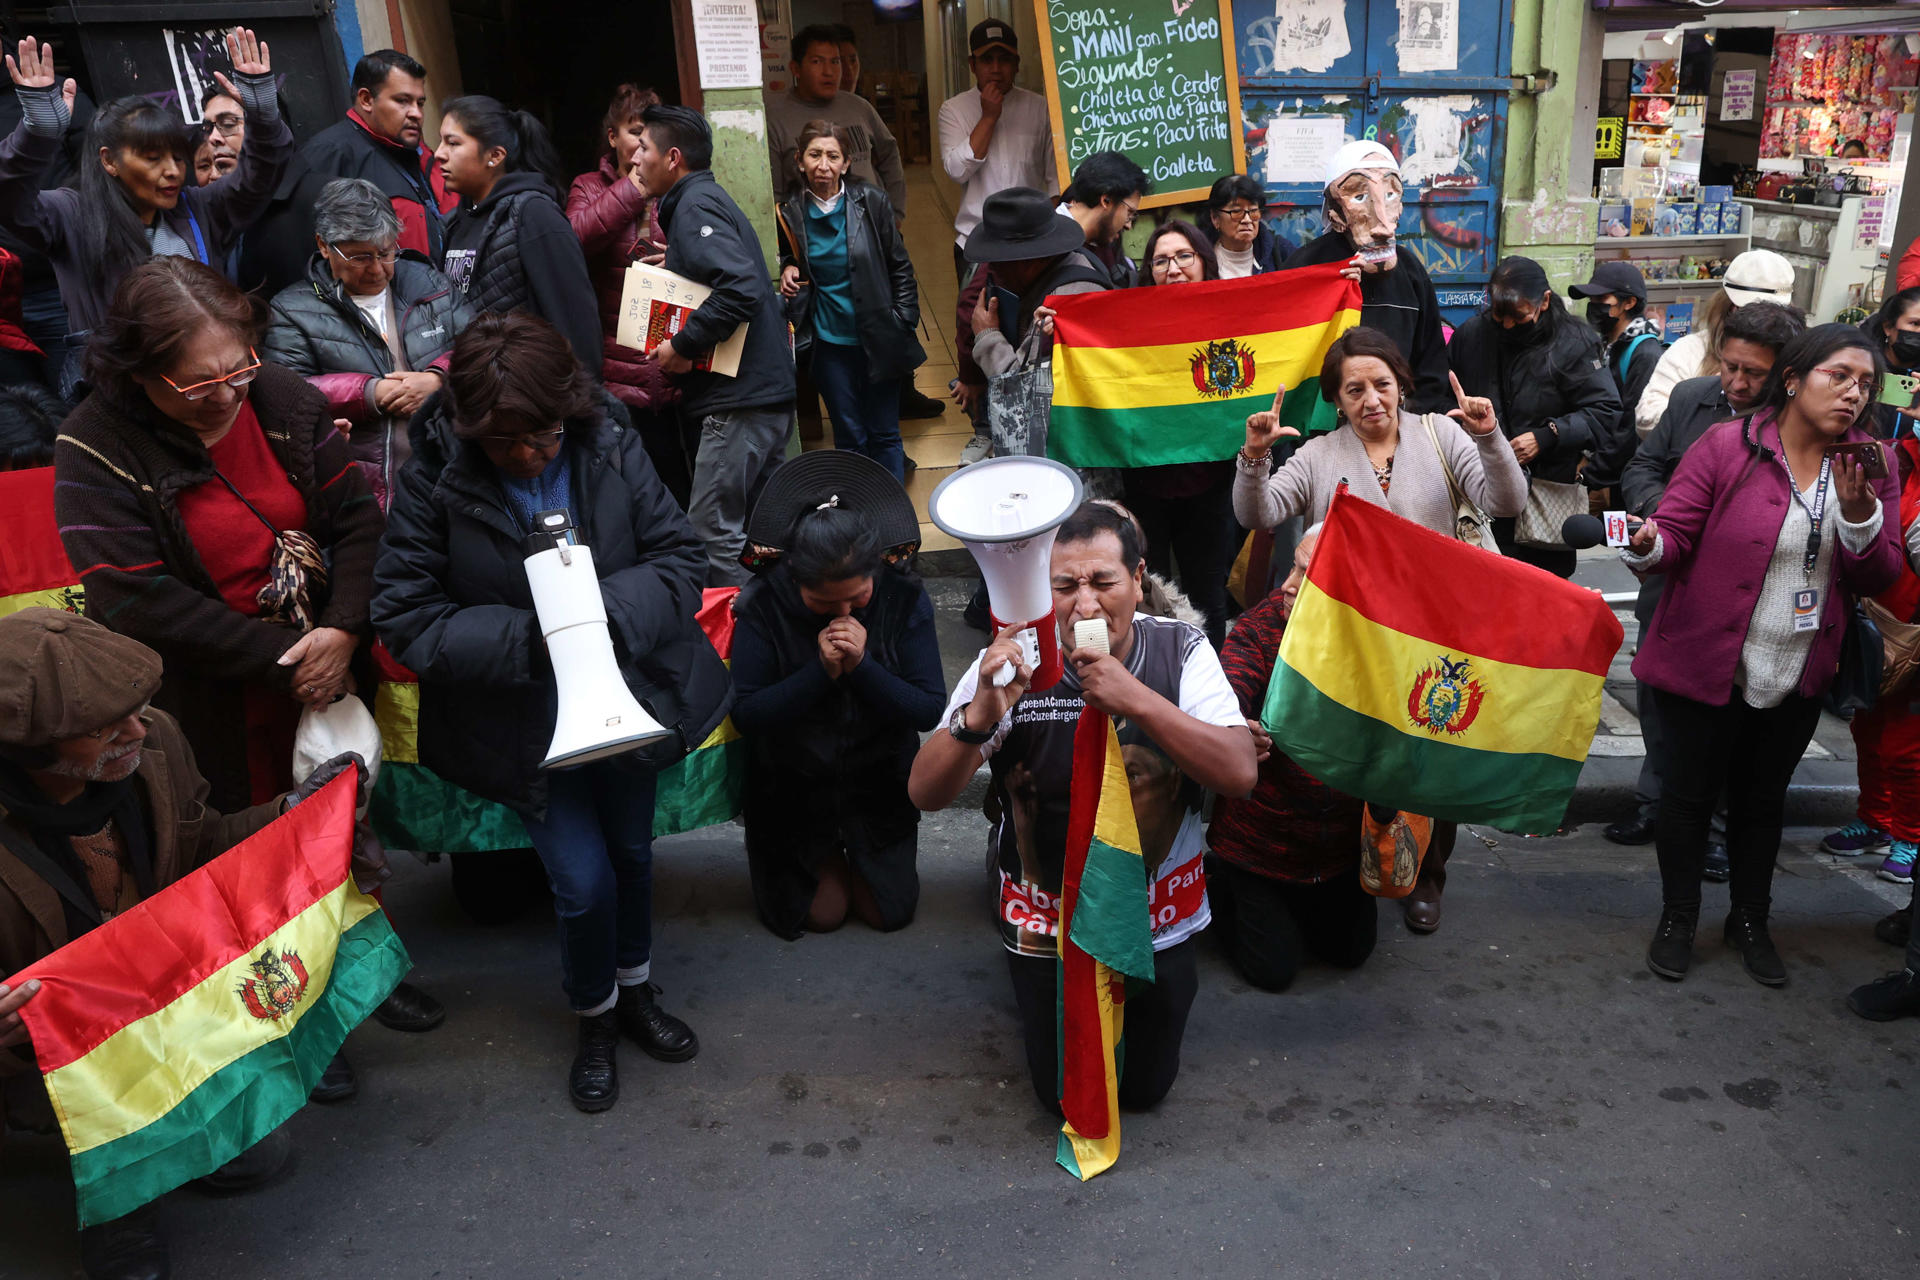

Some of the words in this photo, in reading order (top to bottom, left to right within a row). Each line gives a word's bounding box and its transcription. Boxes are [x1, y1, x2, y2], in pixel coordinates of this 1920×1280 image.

[1050, 2, 1120, 38] Sopa:
[1072, 13, 1134, 60] MANÍ
[1135, 32, 1161, 48] con
[1163, 17, 1218, 44] Fideo
[768, 64, 785, 73] VISA
[1058, 49, 1173, 94] Segundo:
[1079, 86, 1145, 113] Chuleta
[1148, 80, 1165, 101] de
[1171, 70, 1223, 97] Cerdo
[1166, 97, 1184, 121] de
[1070, 127, 1149, 160] Extras:
[1196, 115, 1228, 142] Frito
[1819, 457, 1831, 482] PRENSA
[1814, 491, 1825, 520] PRENSA
